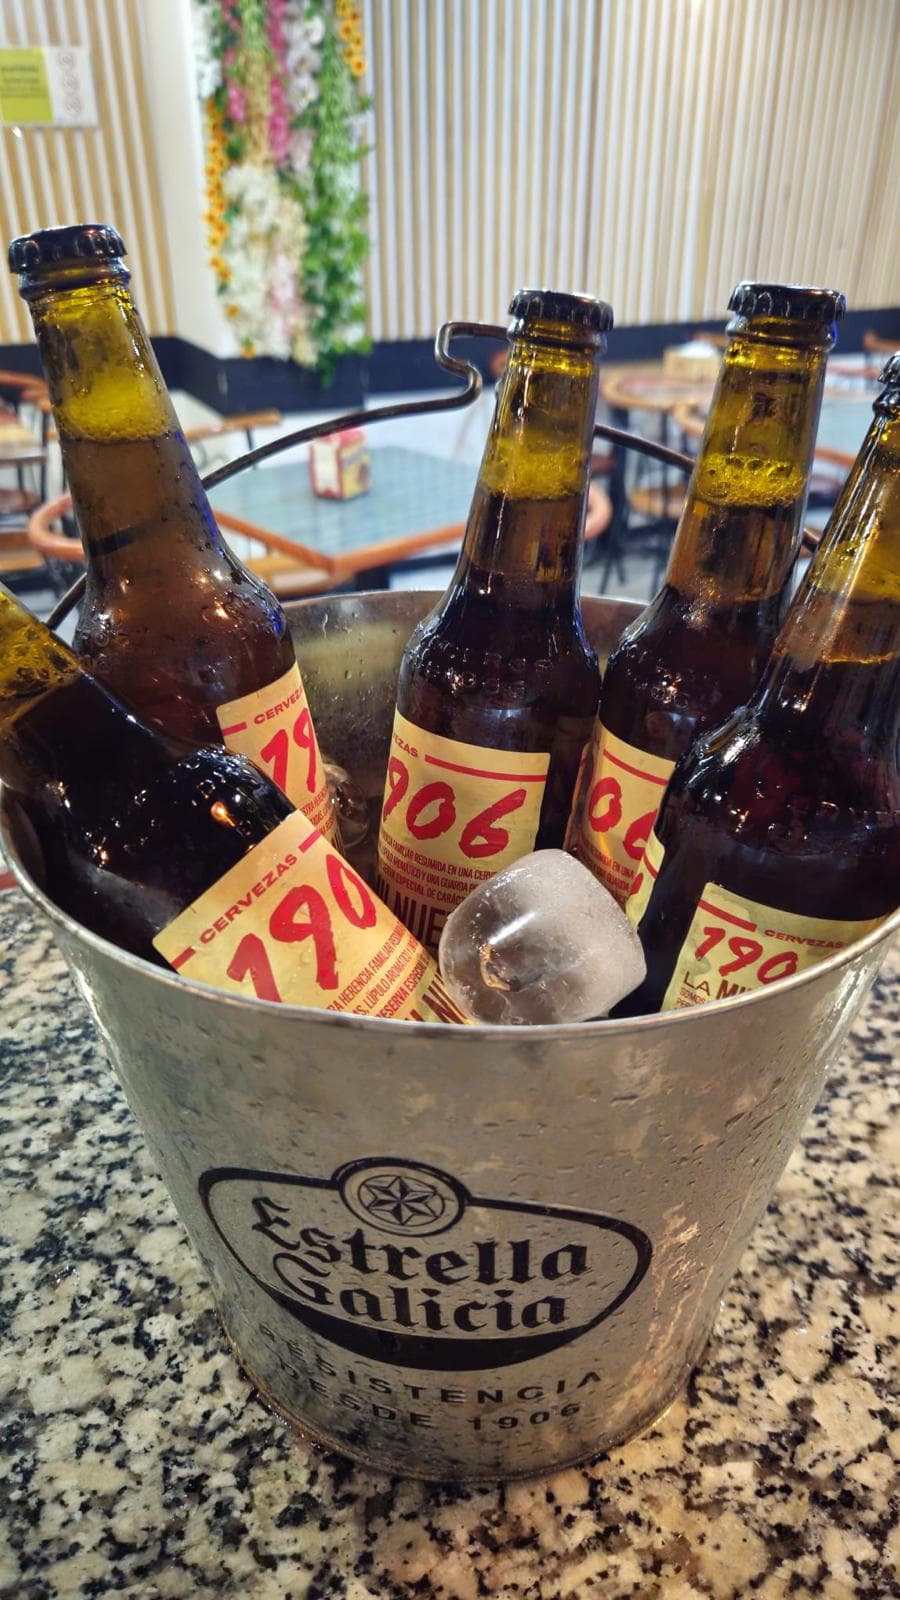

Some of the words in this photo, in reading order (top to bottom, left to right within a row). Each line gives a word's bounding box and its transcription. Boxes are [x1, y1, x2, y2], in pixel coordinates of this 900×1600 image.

[395, 870, 424, 895] ESPECIAL
[426, 888, 436, 900] DE
[414, 853, 446, 872] RESUMIDA
[447, 864, 457, 876] EN
[460, 867, 473, 879] UNA
[440, 877, 468, 892] GUARDA
[200, 854, 298, 944] CERVEZAS
[226, 854, 377, 1004] 190
[764, 929, 845, 949] CERVEZAS
[338, 967, 374, 1006] HERENCIA
[368, 939, 395, 973] FAMILIAR
[694, 926, 799, 985] 190
[684, 971, 710, 996] LA
[251, 1196, 590, 1286] Estrella
[272, 1252, 571, 1333] Galicia
[467, 1403, 580, 1431] 1906
